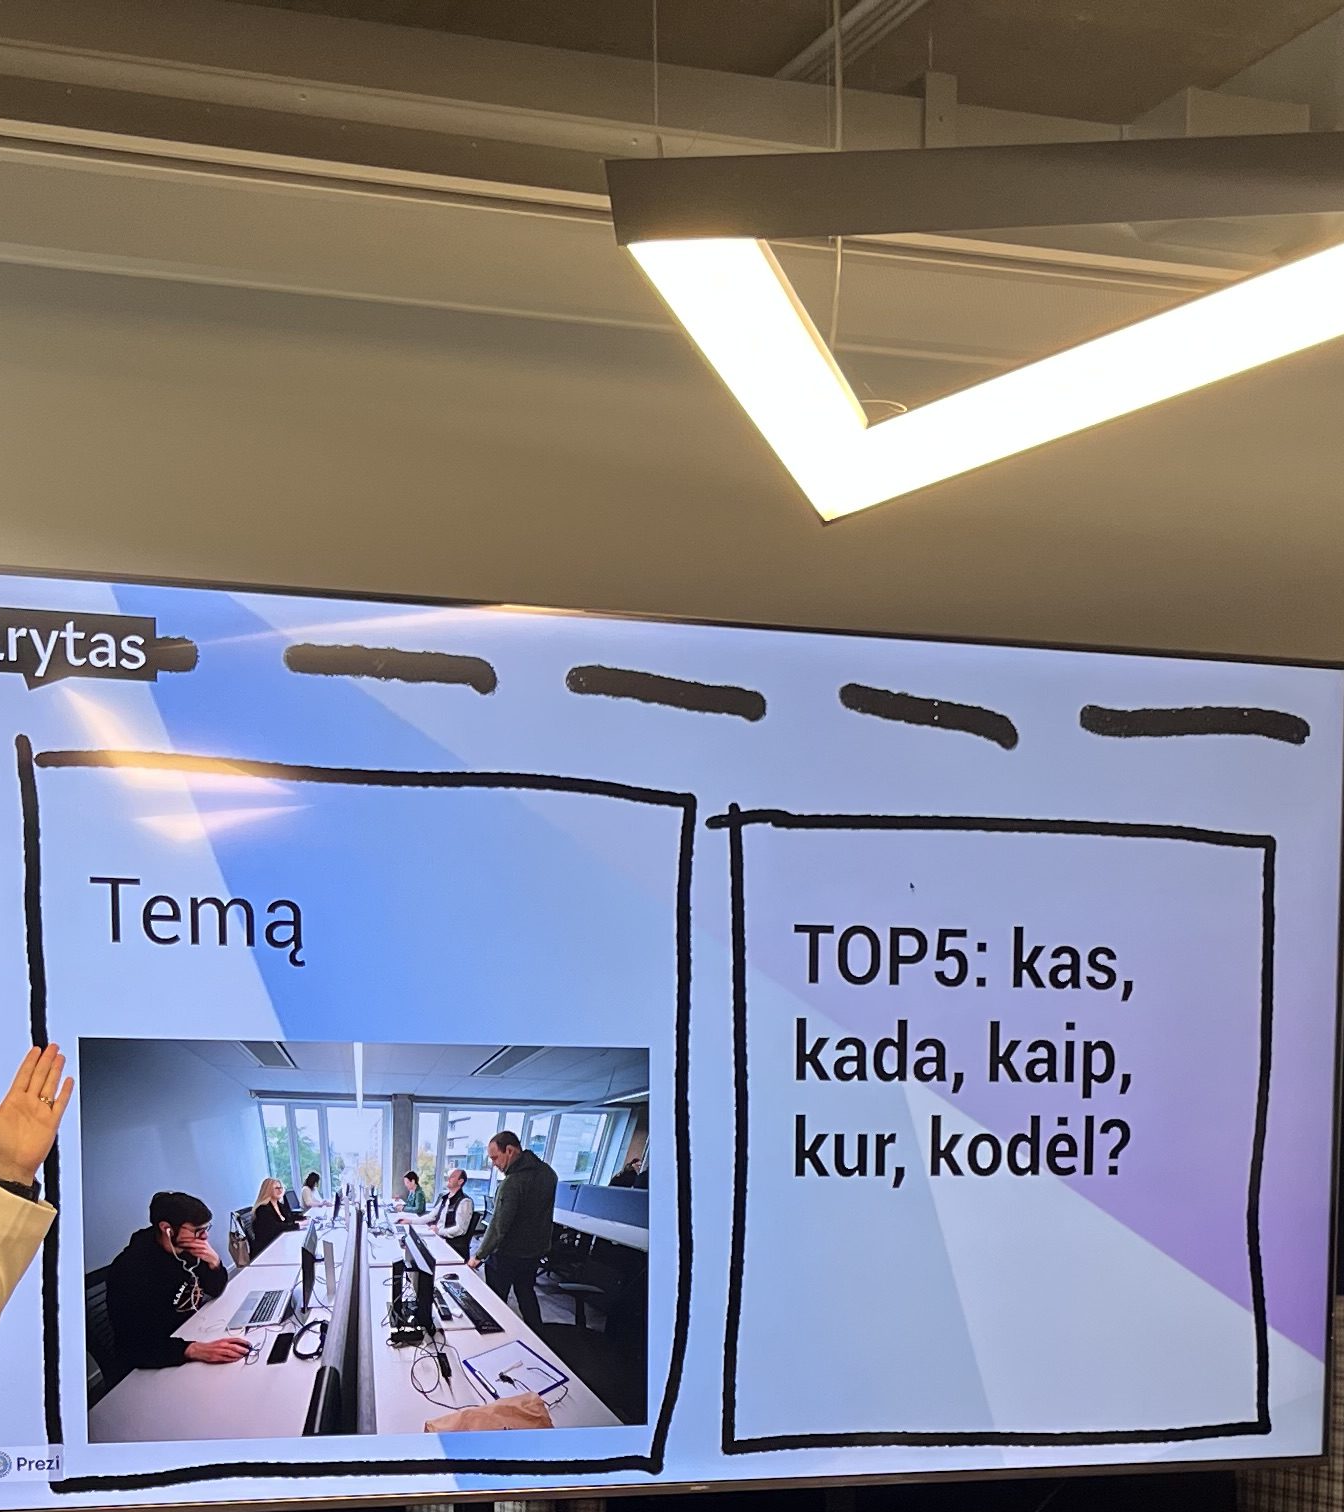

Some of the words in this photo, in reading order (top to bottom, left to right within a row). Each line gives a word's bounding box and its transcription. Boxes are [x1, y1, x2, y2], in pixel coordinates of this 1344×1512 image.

[89, 876, 306, 968] Temą
[794, 924, 988, 988] TOP5:
[1012, 926, 1134, 1002] kas,
[795, 1017, 964, 1094] kada,
[989, 1020, 1133, 1099] kaip,
[794, 1114, 906, 1189] kur,
[930, 1114, 1132, 1178] kodėl?
[16, 1454, 60, 1472] Prezi
